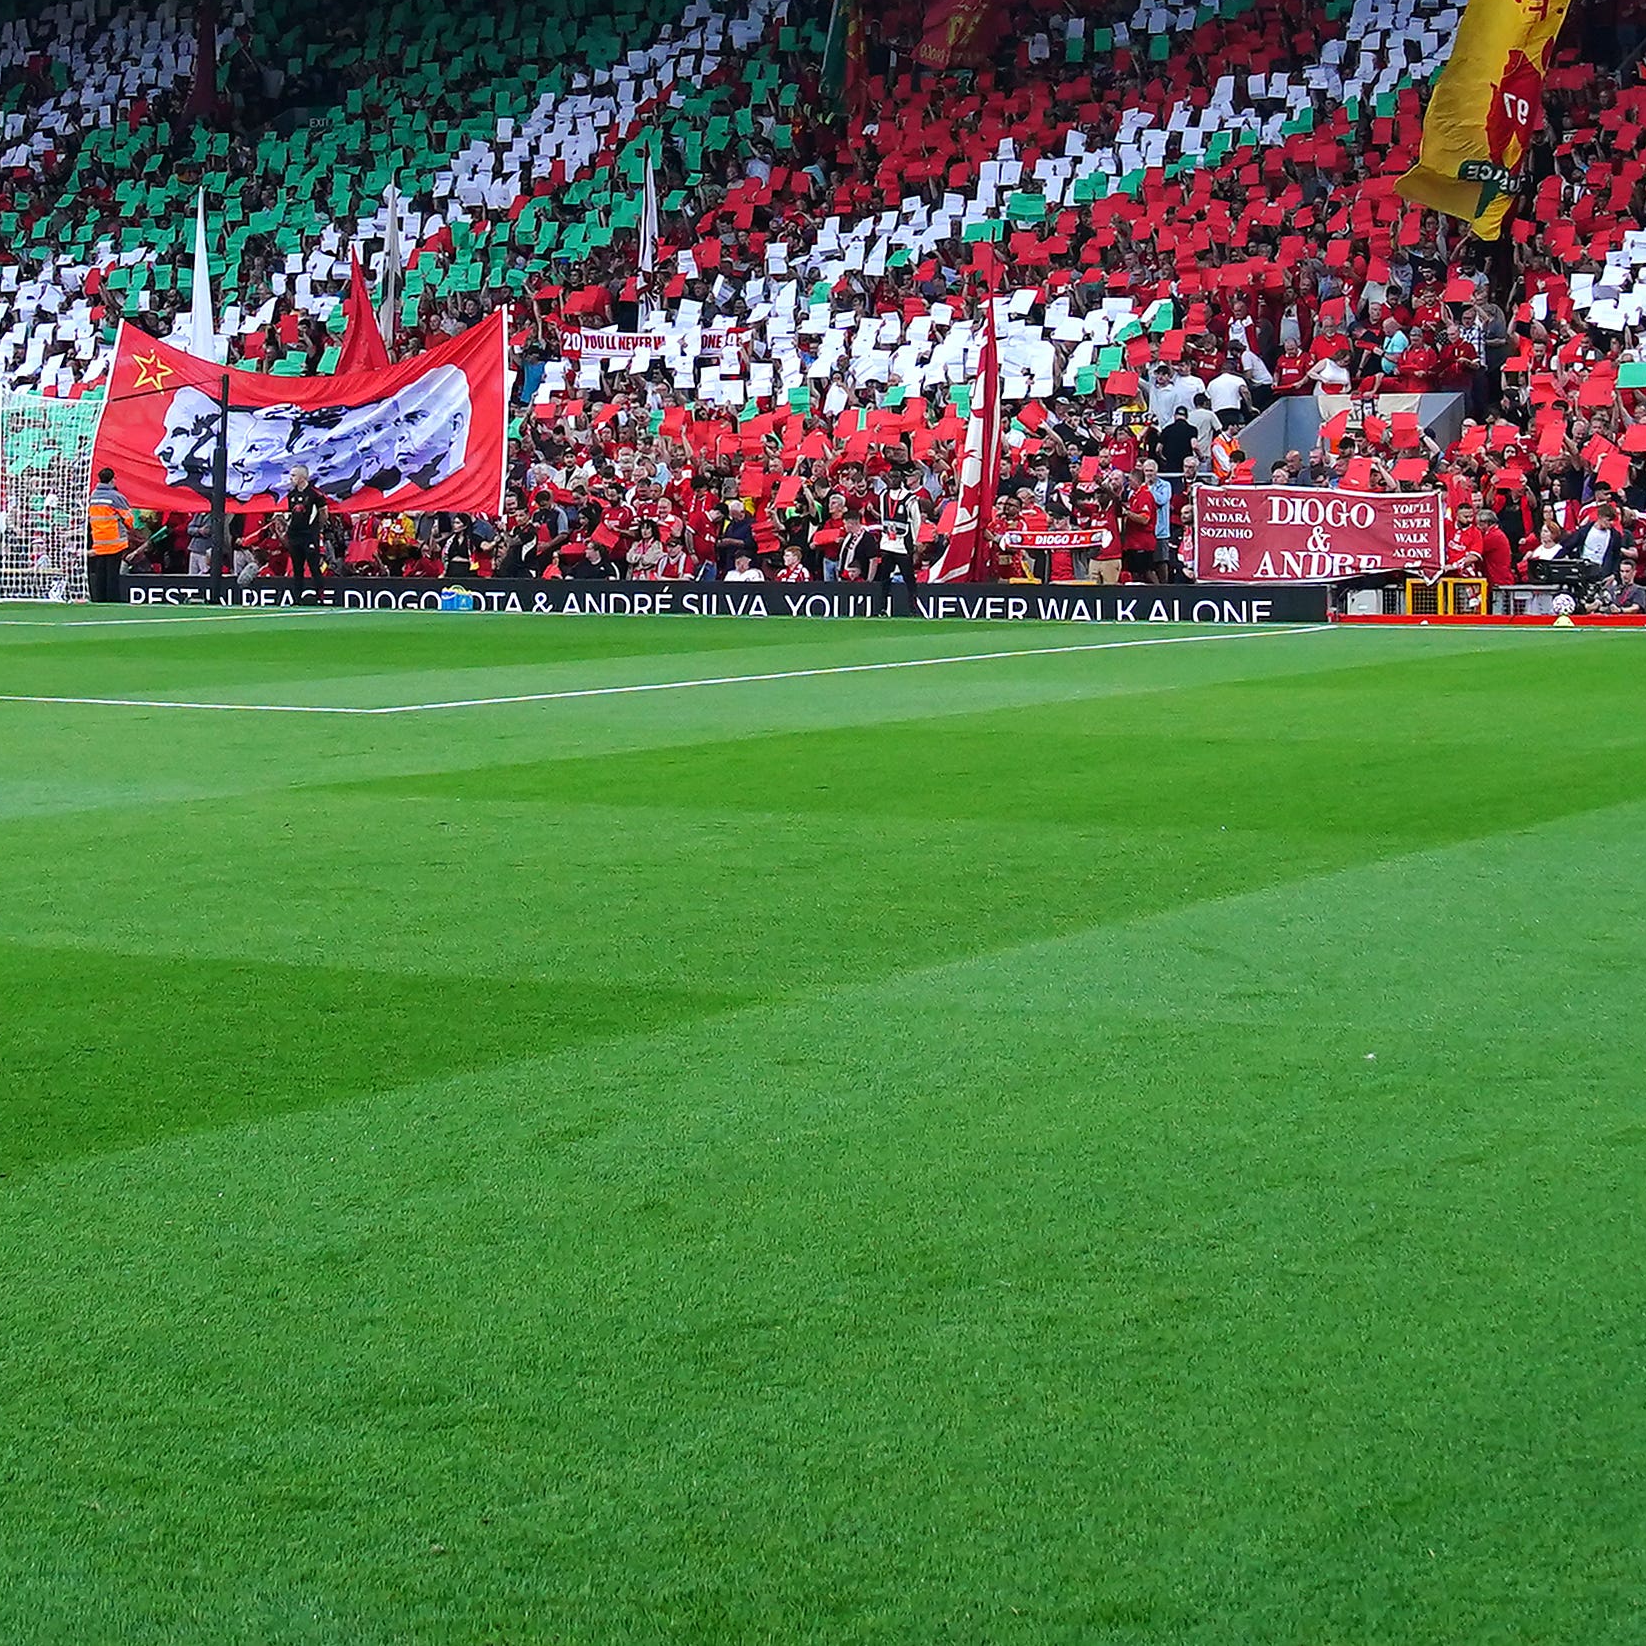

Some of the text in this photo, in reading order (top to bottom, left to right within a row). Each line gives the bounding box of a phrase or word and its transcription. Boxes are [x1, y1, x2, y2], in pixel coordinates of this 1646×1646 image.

[562, 332, 581, 351] 20
[618, 335, 652, 351] NEVER
[1207, 496, 1248, 508] NUNCA
[1267, 496, 1376, 529] DIOGO
[1392, 503, 1434, 515] YOU'LL
[1393, 518, 1431, 529] NEVER
[1035, 533, 1070, 544] DIOGO
[1200, 527, 1253, 539] SOZINHO
[1306, 525, 1331, 553] &
[1395, 533, 1428, 544] WALK
[1392, 548, 1431, 559] ALONE
[344, 590, 442, 610] DIOGO
[472, 592, 523, 613] OTA
[532, 591, 554, 613] &
[563, 586, 672, 615] ANDRÉ
[683, 593, 768, 616] SILVA
[916, 596, 1028, 620] NEVER
[1037, 598, 1138, 622] WALK
[1148, 599, 1273, 623] ALONE
